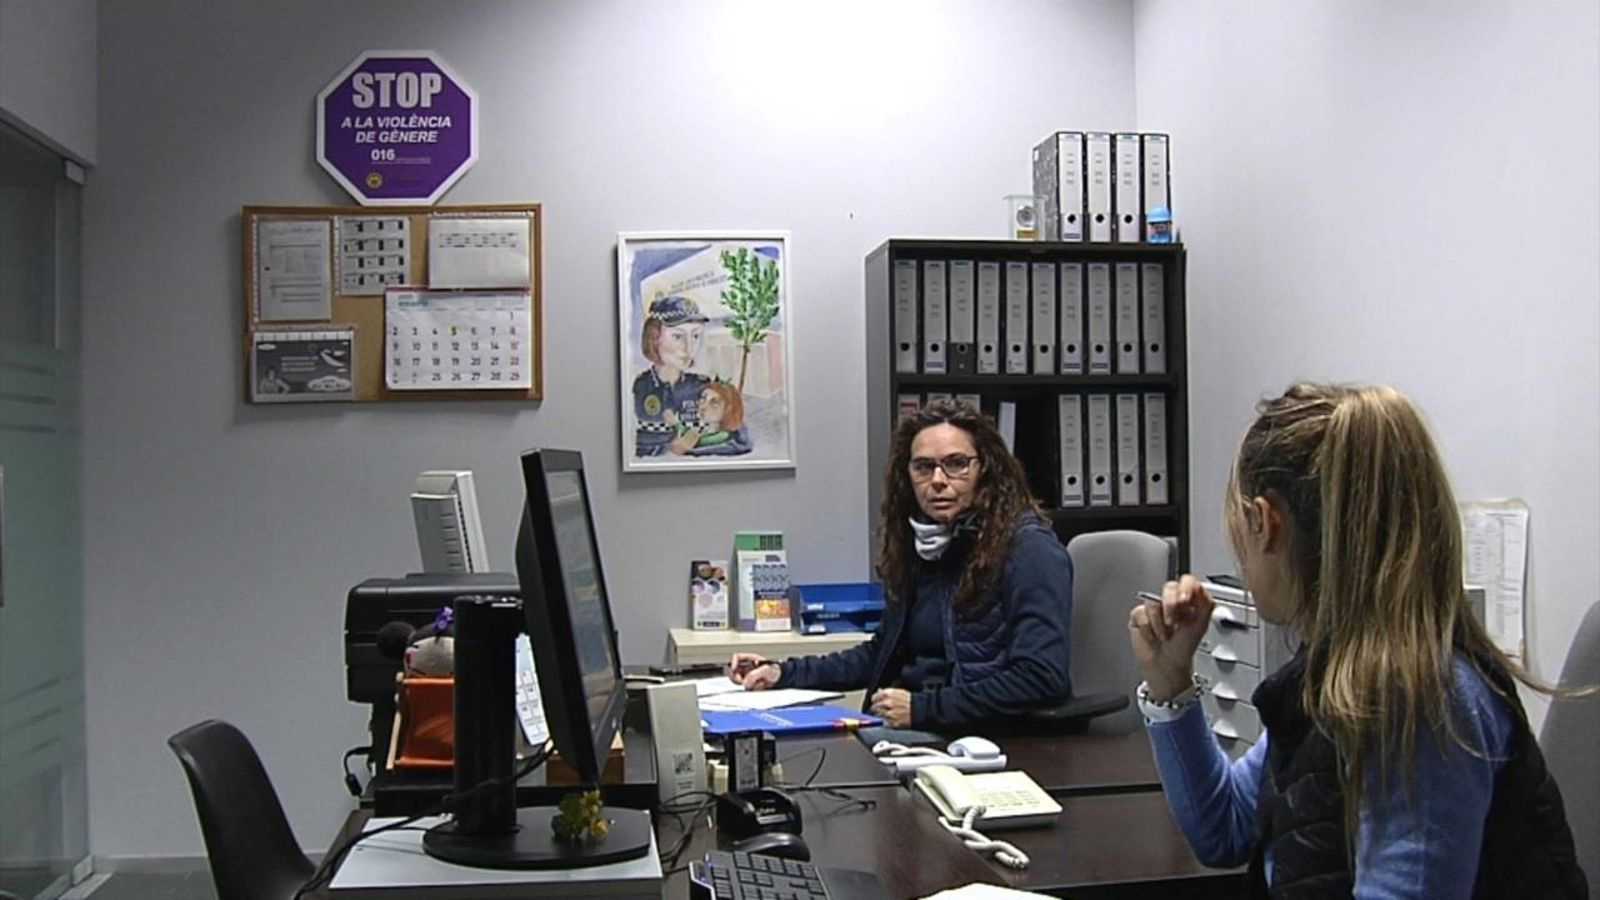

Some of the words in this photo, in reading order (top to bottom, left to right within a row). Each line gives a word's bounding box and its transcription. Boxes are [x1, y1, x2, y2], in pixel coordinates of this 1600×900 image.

[353, 72, 442, 108] STOP
[341, 117, 352, 128] A
[355, 117, 373, 128] LA
[377, 113, 452, 128] VIOLÈNCIA
[356, 132, 375, 143] DE
[371, 149, 395, 160] 016
[393, 327, 398, 336] 2
[412, 327, 418, 336] 3
[432, 327, 438, 336] 4
[451, 327, 457, 336] 5
[490, 327, 496, 336] 7
[412, 342, 421, 351] 10
[452, 342, 460, 351] 12
[471, 342, 479, 351] 13
[490, 342, 499, 351] 14
[412, 358, 420, 366] 17
[432, 358, 440, 366] 18
[451, 358, 460, 366] 19
[432, 373, 441, 381] 25
[451, 373, 461, 381] 26
[471, 373, 481, 381] 27
